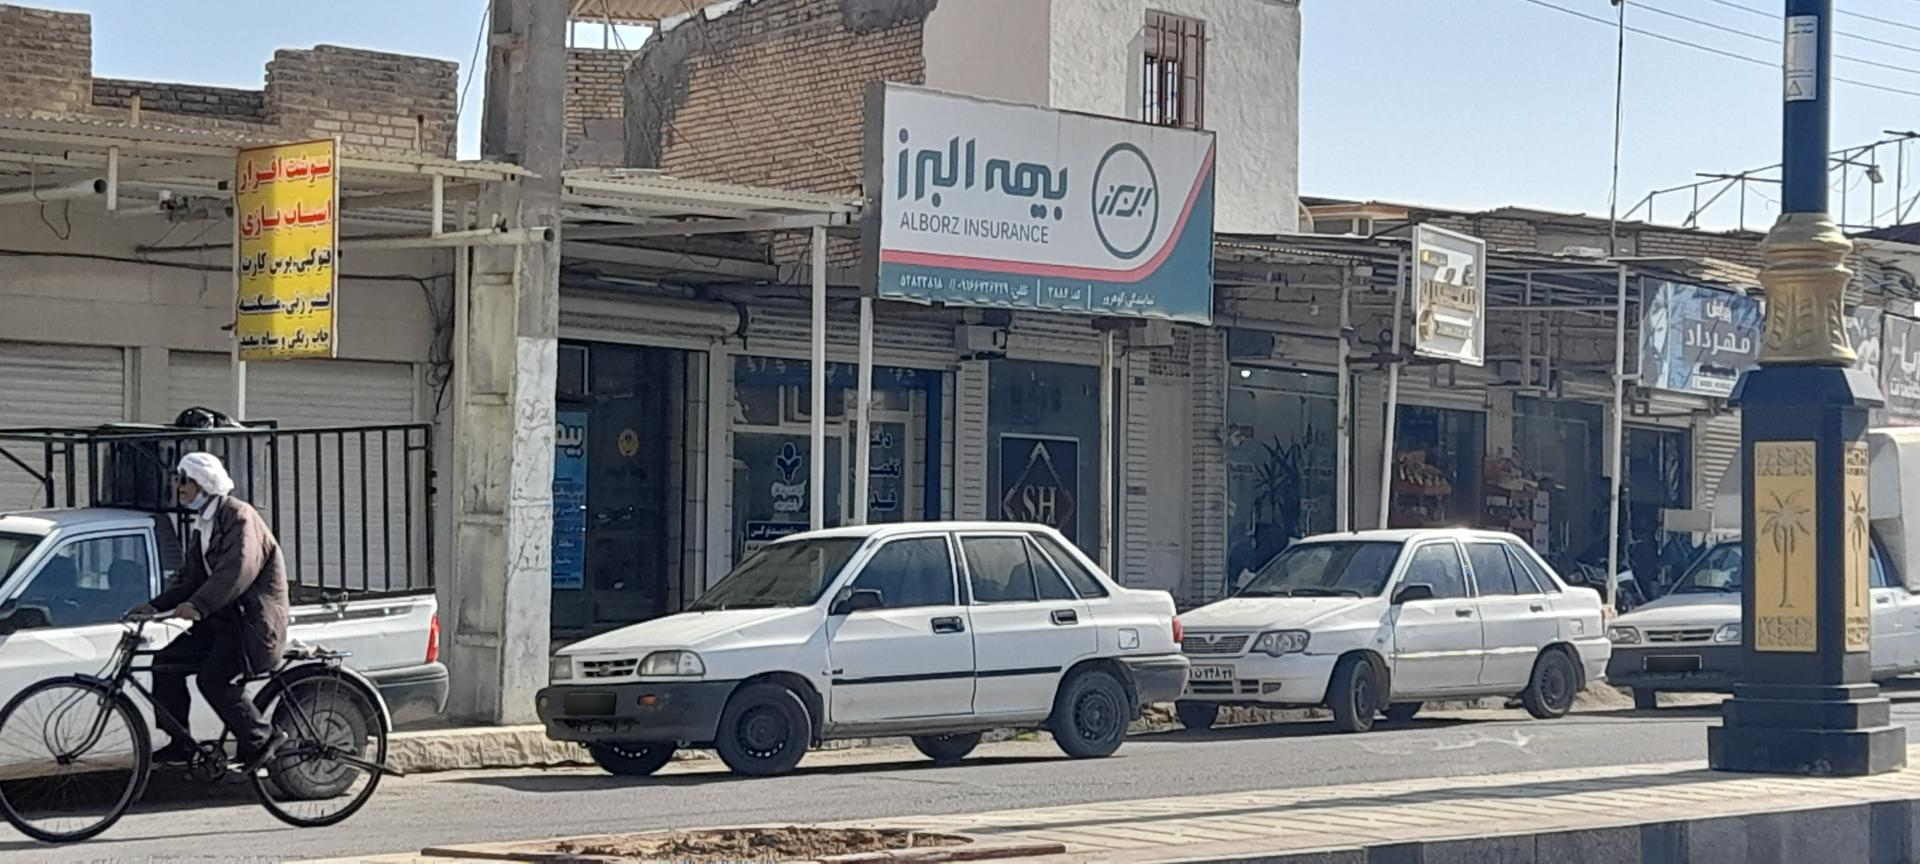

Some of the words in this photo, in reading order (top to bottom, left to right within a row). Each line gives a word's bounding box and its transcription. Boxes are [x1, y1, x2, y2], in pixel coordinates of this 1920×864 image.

[240, 154, 282, 191] افزار
[286, 150, 332, 185] نوشت
[897, 128, 976, 208] البرز
[984, 159, 1068, 221] بیمه
[242, 205, 280, 237] بازی
[285, 200, 332, 236] اسباب
[900, 211, 960, 235] ALBORZ
[964, 219, 1050, 244] INSURANCE
[1685, 323, 1751, 355] مهرداد
[1022, 485, 1057, 524] SH
